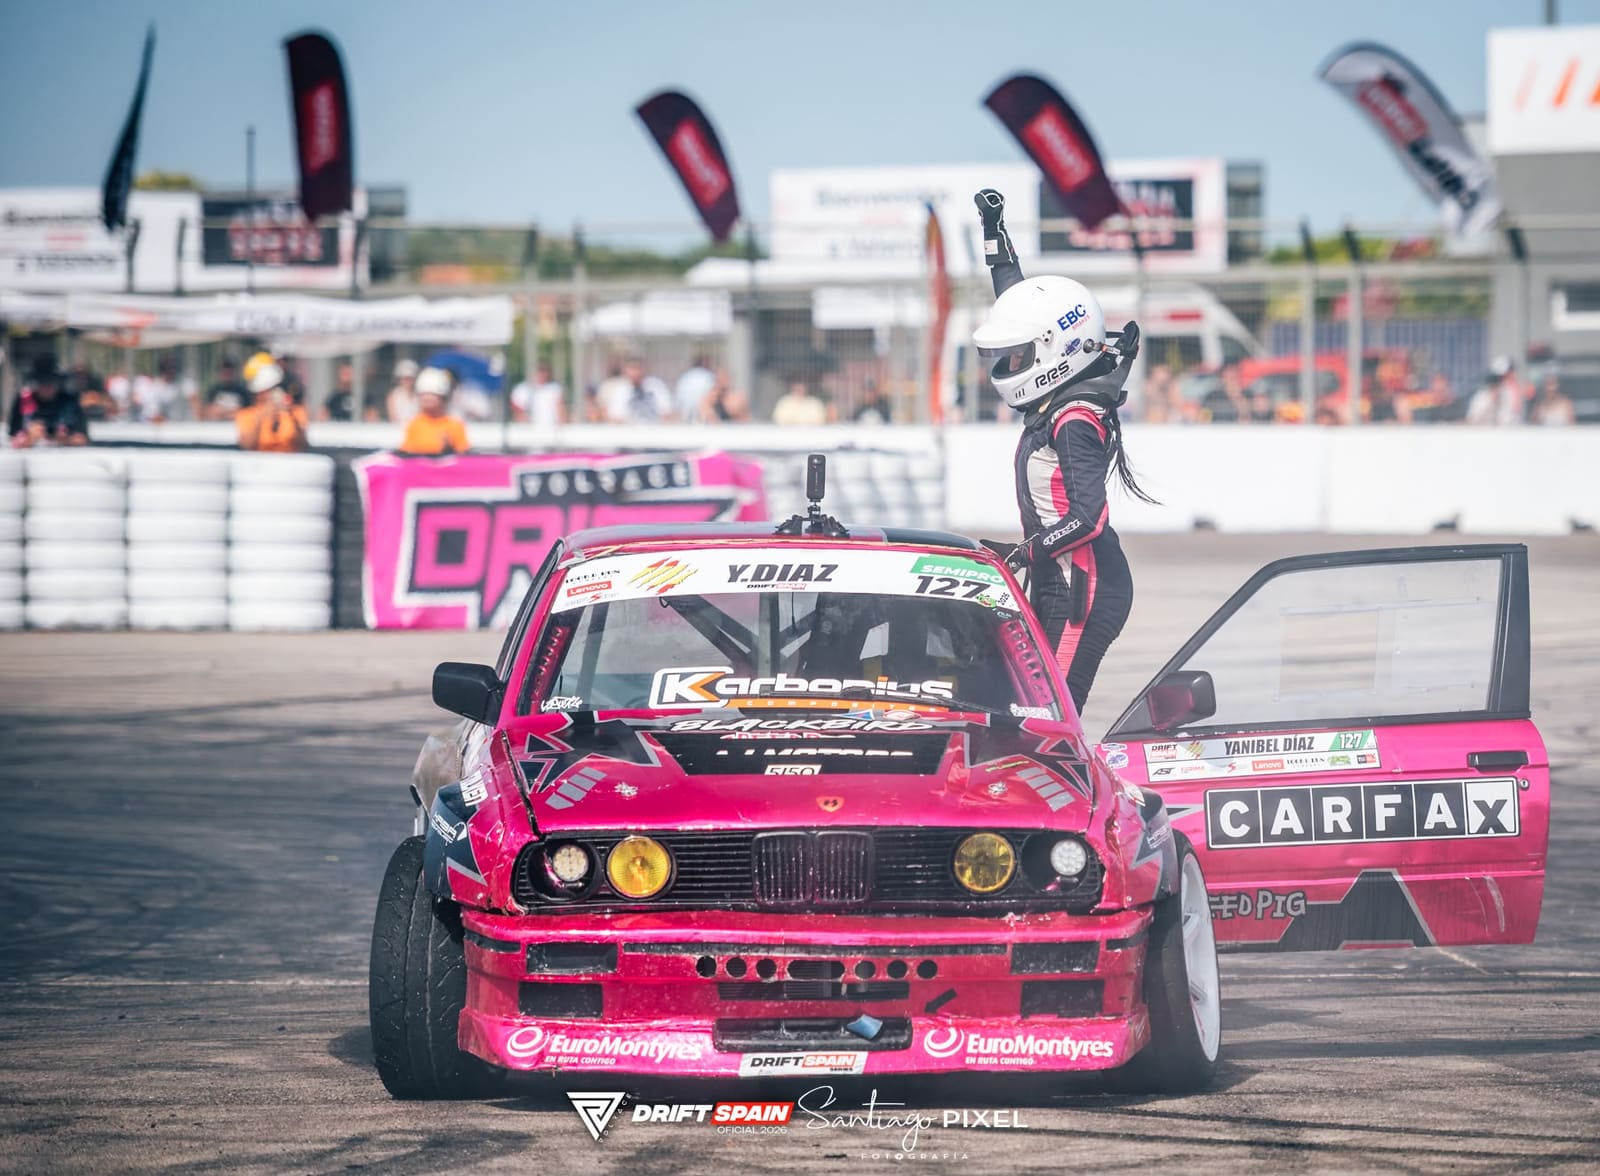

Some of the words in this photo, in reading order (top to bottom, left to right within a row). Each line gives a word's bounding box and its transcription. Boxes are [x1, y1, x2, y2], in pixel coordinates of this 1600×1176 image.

[1057, 304, 1087, 331] EBC
[1034, 360, 1070, 388] RRS
[728, 563, 838, 583] Y.DIAZ
[920, 564, 1002, 584] SEMIPRO
[569, 582, 609, 595] Lenovo
[915, 575, 991, 599] 127
[660, 671, 953, 704] Karbonius
[671, 718, 934, 732] BLACKBIRD
[1151, 743, 1178, 751] DRIFT
[1224, 739, 1281, 756] YANIBEL
[1283, 733, 1314, 752] DÍAZ
[1339, 732, 1363, 750] 127
[1254, 761, 1282, 771] Lenovo
[1219, 791, 1508, 838] CARFAX
[1255, 889, 1306, 920] PIG
[548, 1035, 701, 1063] EuroMontyres
[967, 1033, 1114, 1058] EuroMontyres
[558, 1056, 579, 1064] RUTA
[581, 1057, 616, 1065] CONTIGO
[750, 1056, 804, 1067] DRIFT
[804, 1055, 855, 1066] SPAIN
[978, 1057, 998, 1065] RUTA
[1000, 1057, 1034, 1065] CONTIGO
